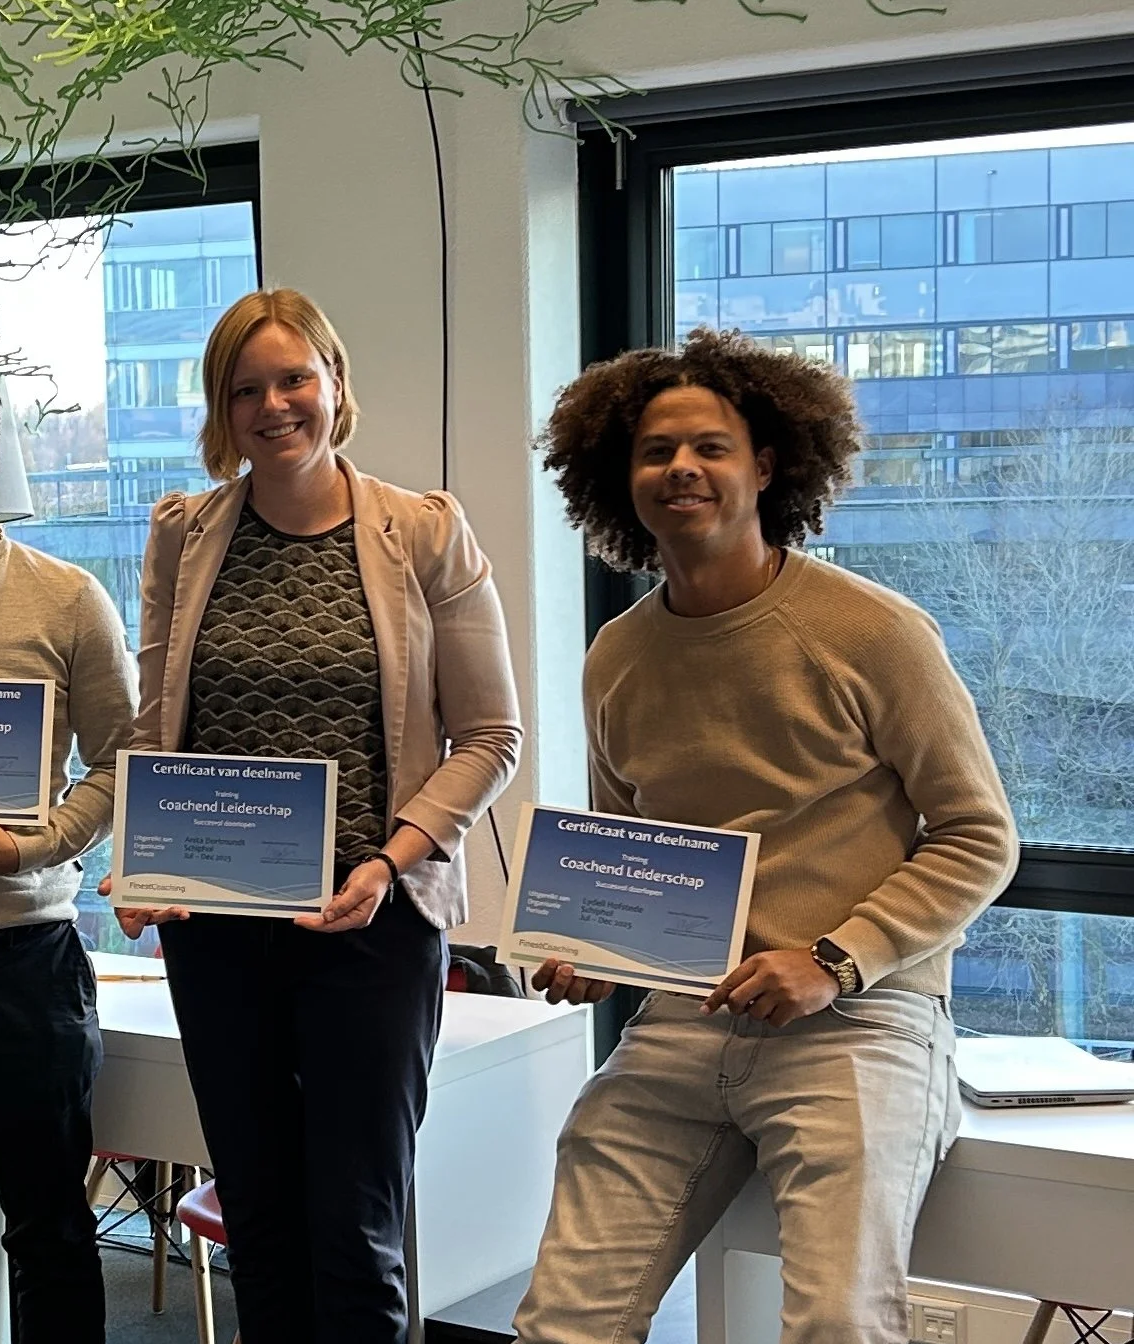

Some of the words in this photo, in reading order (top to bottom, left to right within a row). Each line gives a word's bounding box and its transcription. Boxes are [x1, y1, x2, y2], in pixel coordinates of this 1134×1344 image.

[152, 763, 215, 776] Certificaat
[218, 768, 239, 777] van
[243, 766, 302, 780] deelname
[159, 799, 217, 813] Coachend
[221, 802, 292, 818] Leiderschap
[558, 819, 625, 840] Certificaat
[627, 830, 652, 842] van
[654, 833, 719, 852] deelname
[560, 857, 624, 875] Coachend
[627, 867, 704, 890] Leiderschap
